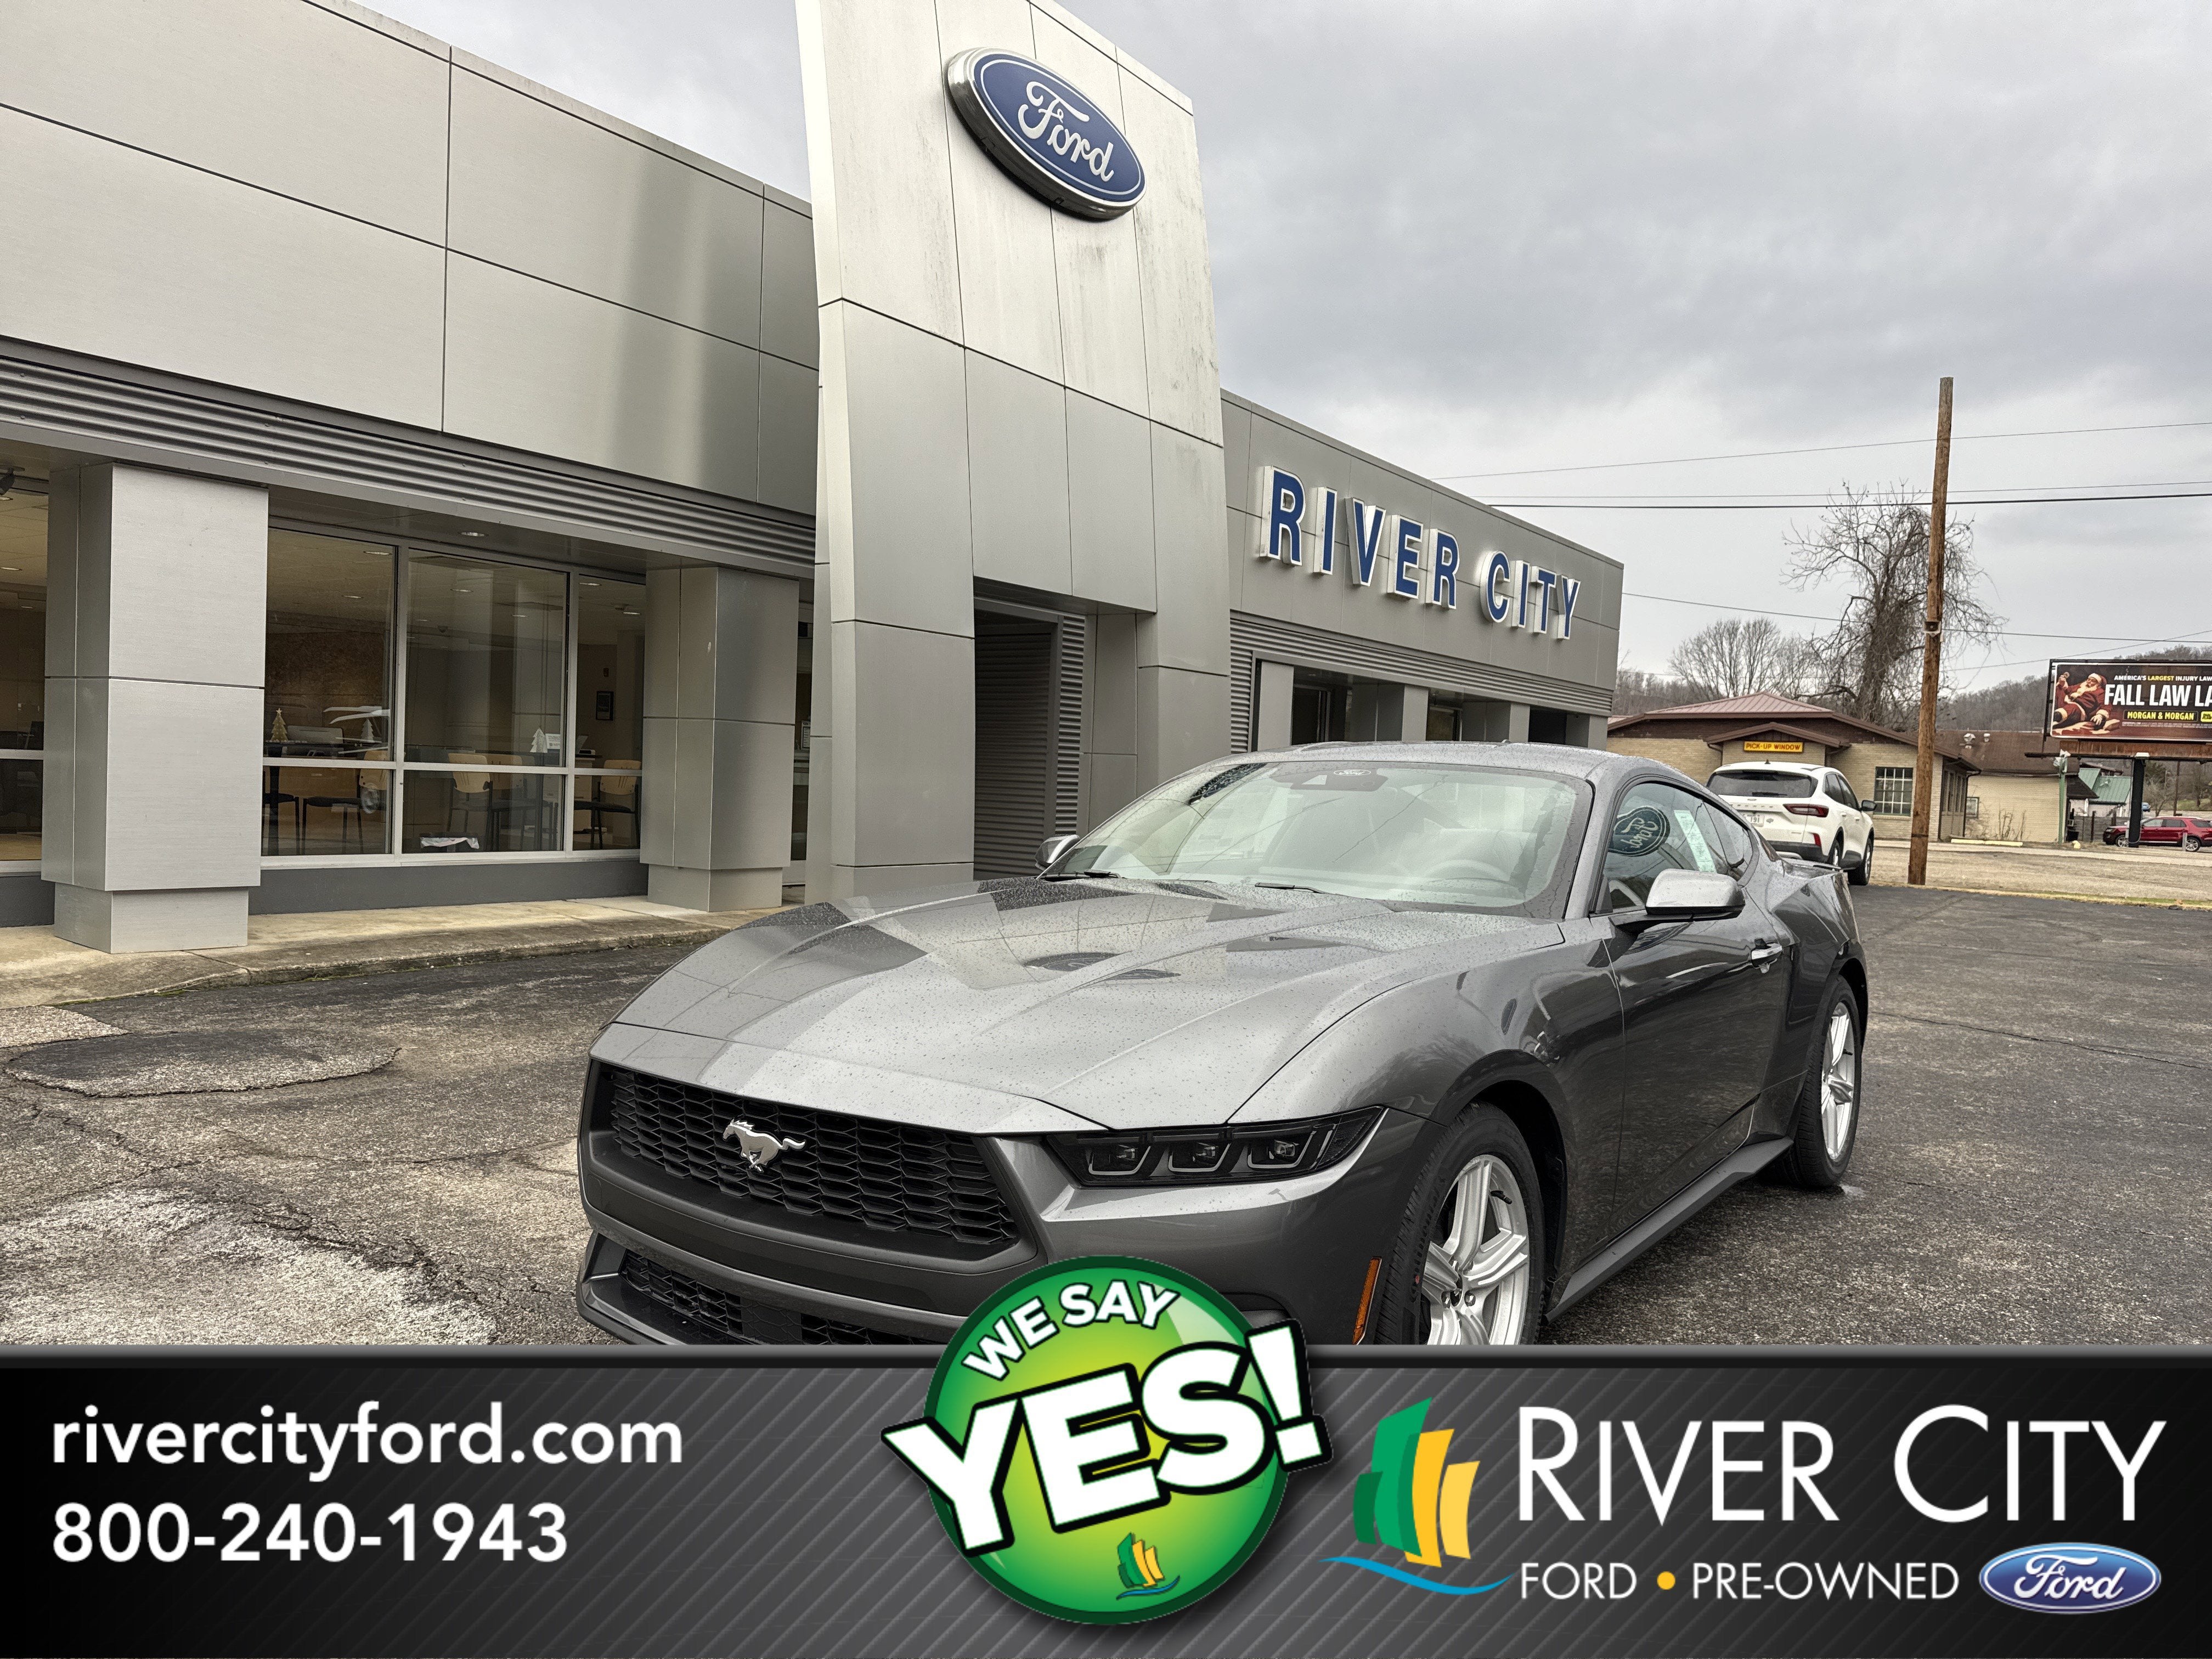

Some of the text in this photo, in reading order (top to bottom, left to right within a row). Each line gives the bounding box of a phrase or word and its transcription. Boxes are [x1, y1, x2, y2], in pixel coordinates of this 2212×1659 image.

[1018, 81, 1114, 182] Ford
[1261, 465, 1581, 640] RIVER CITY
[2104, 684, 2145, 706] FALL
[2149, 685, 2191, 706] LAW
[2127, 711, 2157, 720] MORGAN
[2164, 712, 2194, 720] MORGAN
